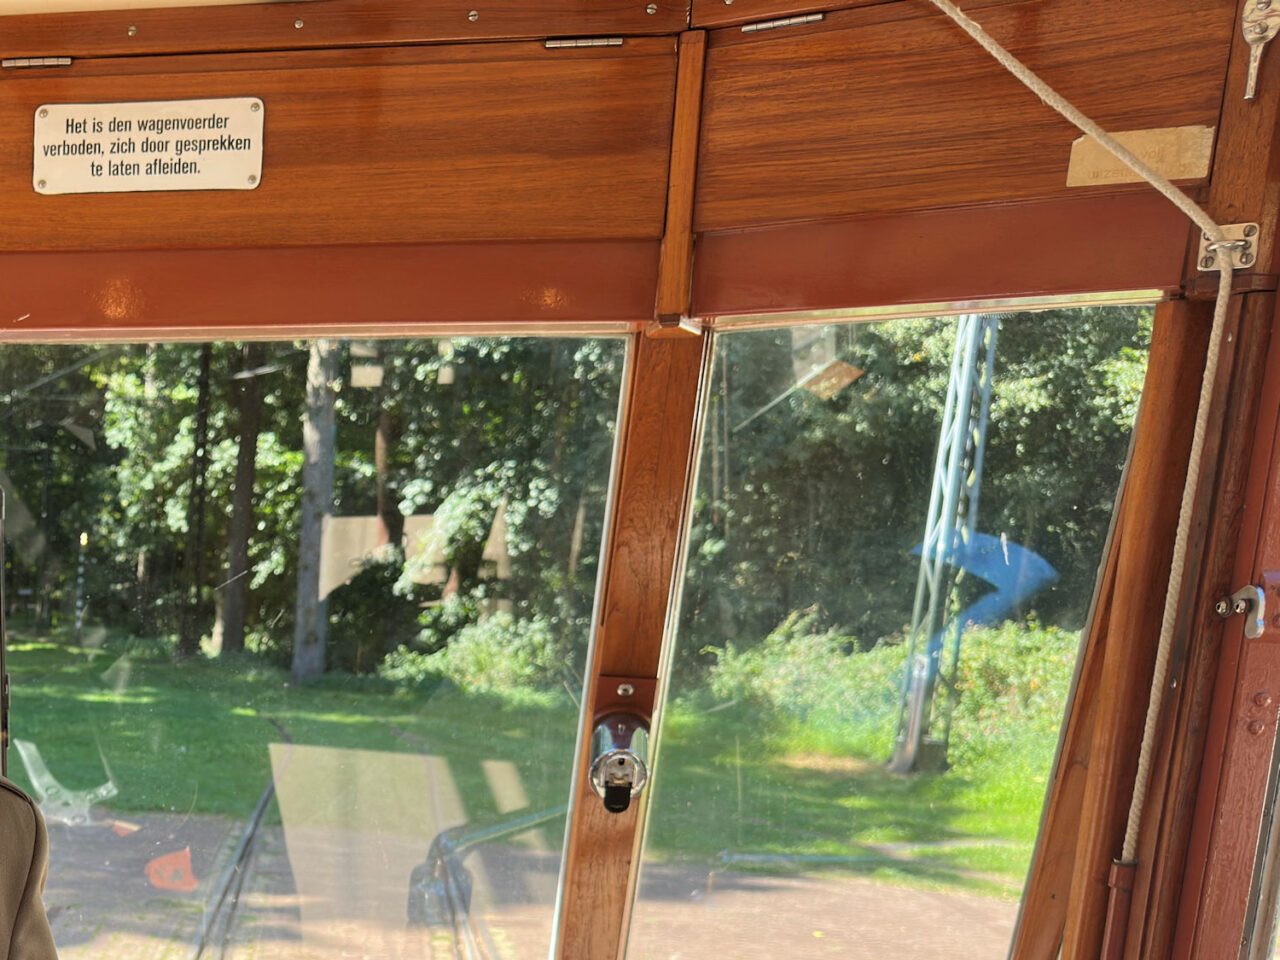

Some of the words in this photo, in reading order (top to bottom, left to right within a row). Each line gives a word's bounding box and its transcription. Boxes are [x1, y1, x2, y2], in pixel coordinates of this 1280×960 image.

[65, 118, 87, 134] Het
[92, 117, 103, 133] is
[108, 116, 132, 133] den
[136, 113, 230, 135] wagenvoerder
[42, 139, 105, 157] verboden,
[109, 137, 136, 154] zich
[140, 136, 170, 153] door
[175, 134, 251, 156] gesprekken
[90, 161, 103, 177] te
[108, 159, 140, 176] laten
[145, 157, 201, 175] afleiden.
